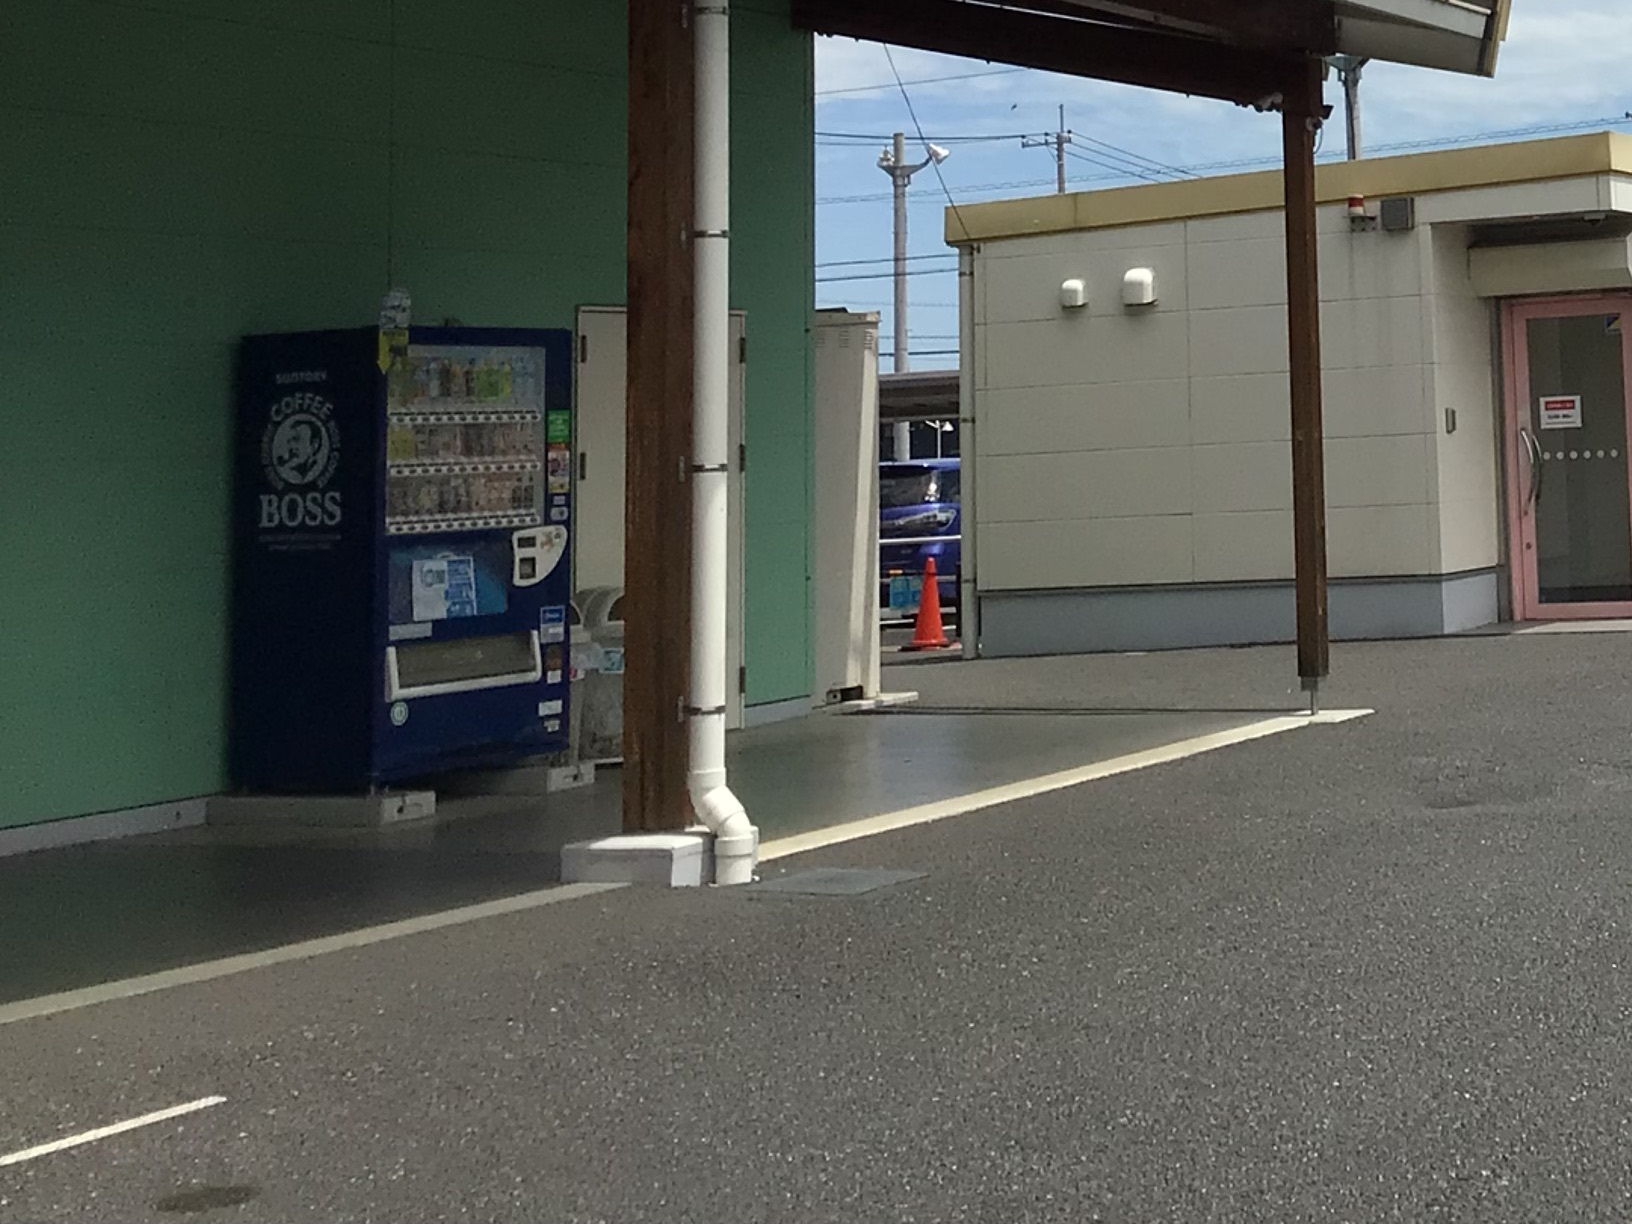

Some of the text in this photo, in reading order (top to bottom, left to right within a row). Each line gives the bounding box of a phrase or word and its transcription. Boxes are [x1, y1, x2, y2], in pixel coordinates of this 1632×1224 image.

[276, 370, 327, 384] SUNTORY
[271, 392, 334, 423] COFFEE
[258, 491, 342, 529] BOSS
